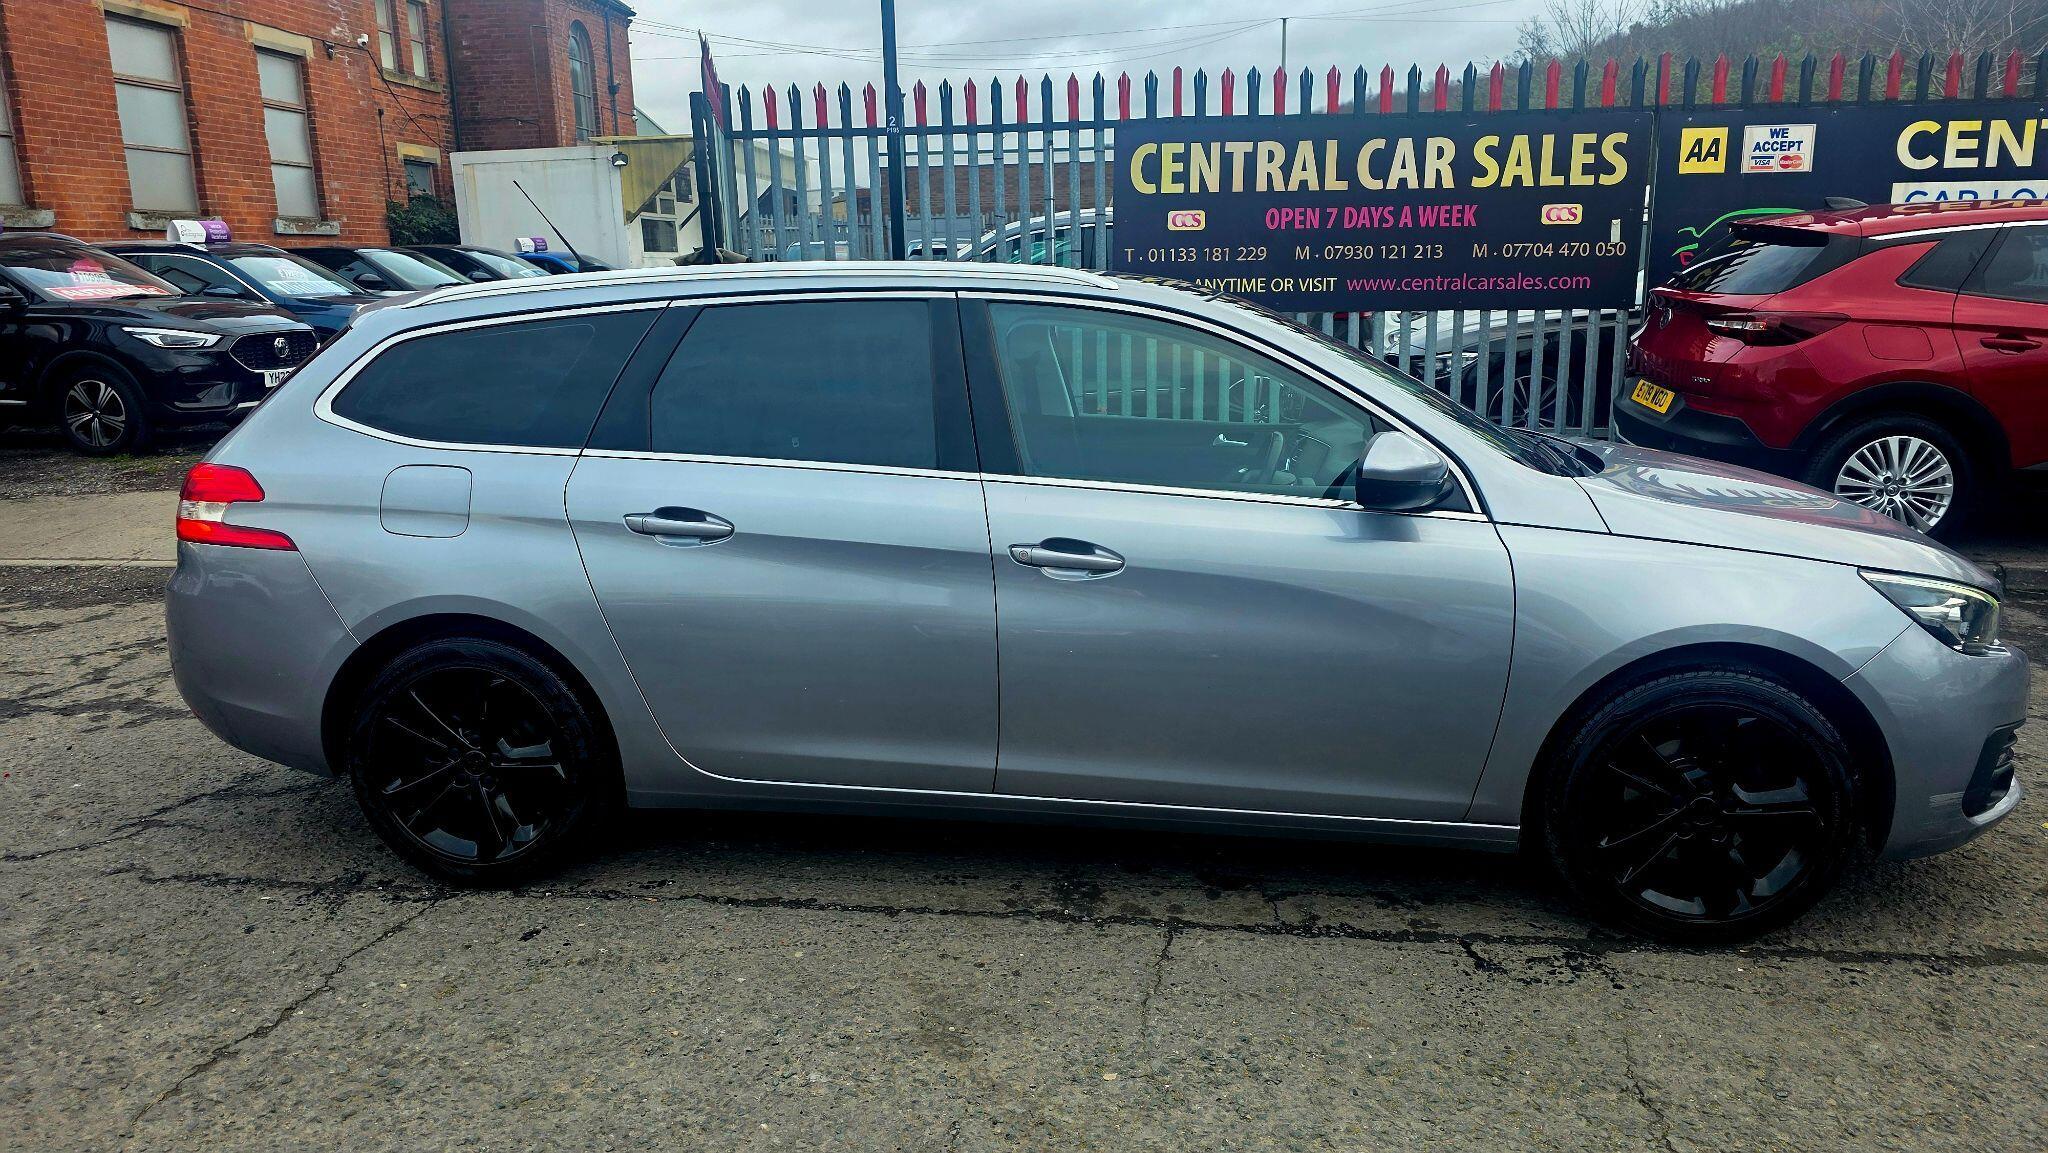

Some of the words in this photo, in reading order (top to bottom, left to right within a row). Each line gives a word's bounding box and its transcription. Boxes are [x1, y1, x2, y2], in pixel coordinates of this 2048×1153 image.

[888, 115, 896, 126] 2
[1769, 127, 1790, 139] WE
[1684, 137, 1721, 163] AA
[1752, 140, 1804, 153] ACCEPT
[1130, 138, 1349, 194] CENTRAL
[1356, 136, 1456, 190] CAR
[1472, 133, 1630, 187] SALES
[1265, 207, 1320, 230] OPEN
[1326, 207, 1339, 229] 7
[1343, 206, 1395, 229] DAYS
[1399, 205, 1413, 228] A
[1418, 204, 1479, 228] WEEK
[1148, 247, 1197, 263] 01133
[1204, 247, 1230, 262] 181
[1236, 246, 1268, 261] 229
[1324, 245, 1374, 260] 07930
[1380, 244, 1406, 259] 121
[1413, 244, 1444, 259] 213
[1502, 242, 1554, 258] 07704
[1558, 242, 1590, 257] 470
[1595, 241, 1627, 256] 050
[1270, 278, 1294, 292] OR
[1299, 277, 1338, 292] VISIT
[1347, 272, 1591, 291] www.centralcarsales.com
[268, 371, 291, 384] YH2
